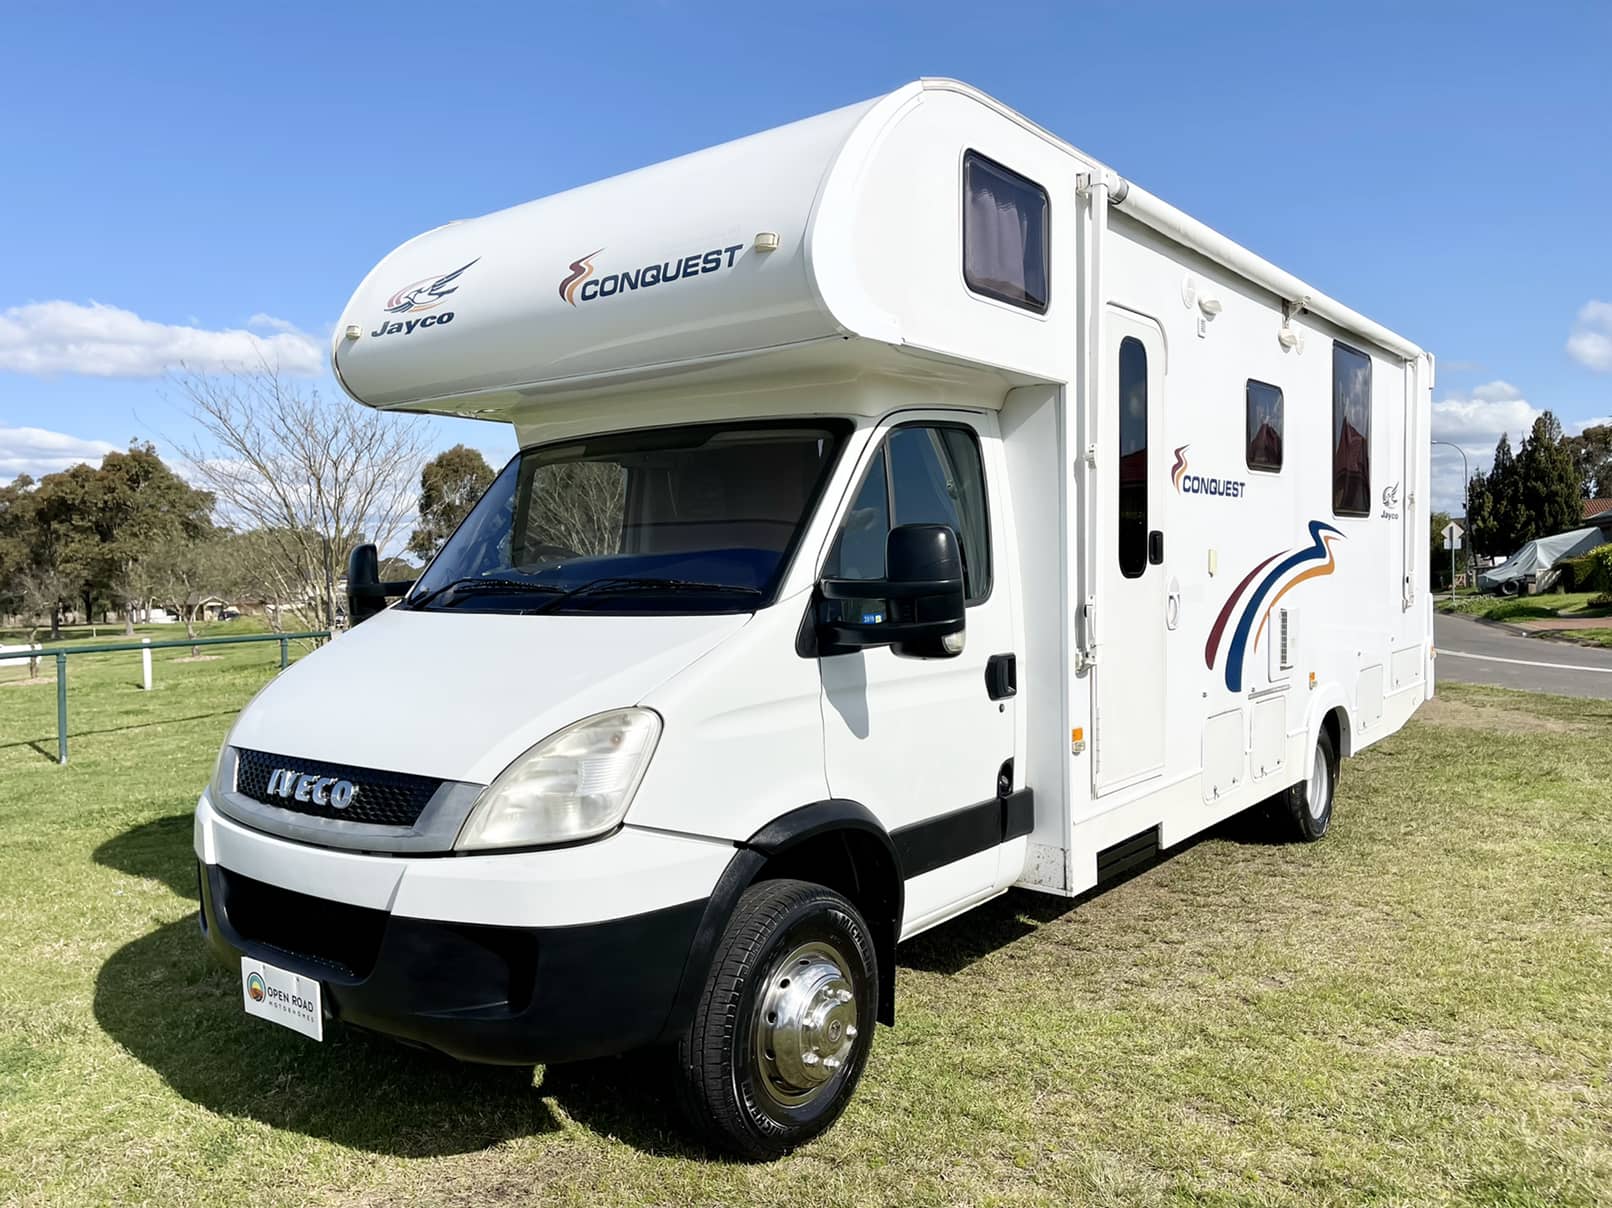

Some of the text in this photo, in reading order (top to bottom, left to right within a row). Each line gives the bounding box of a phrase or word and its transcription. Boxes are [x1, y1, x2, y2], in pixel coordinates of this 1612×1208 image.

[581, 244, 744, 302] CONQUEST
[371, 310, 455, 338] Jayco
[1182, 475, 1246, 498] CONQUEST
[1380, 510, 1399, 520] Jayco
[266, 768, 357, 809] IVECO
[267, 986, 314, 1012] OPEN ROAD
